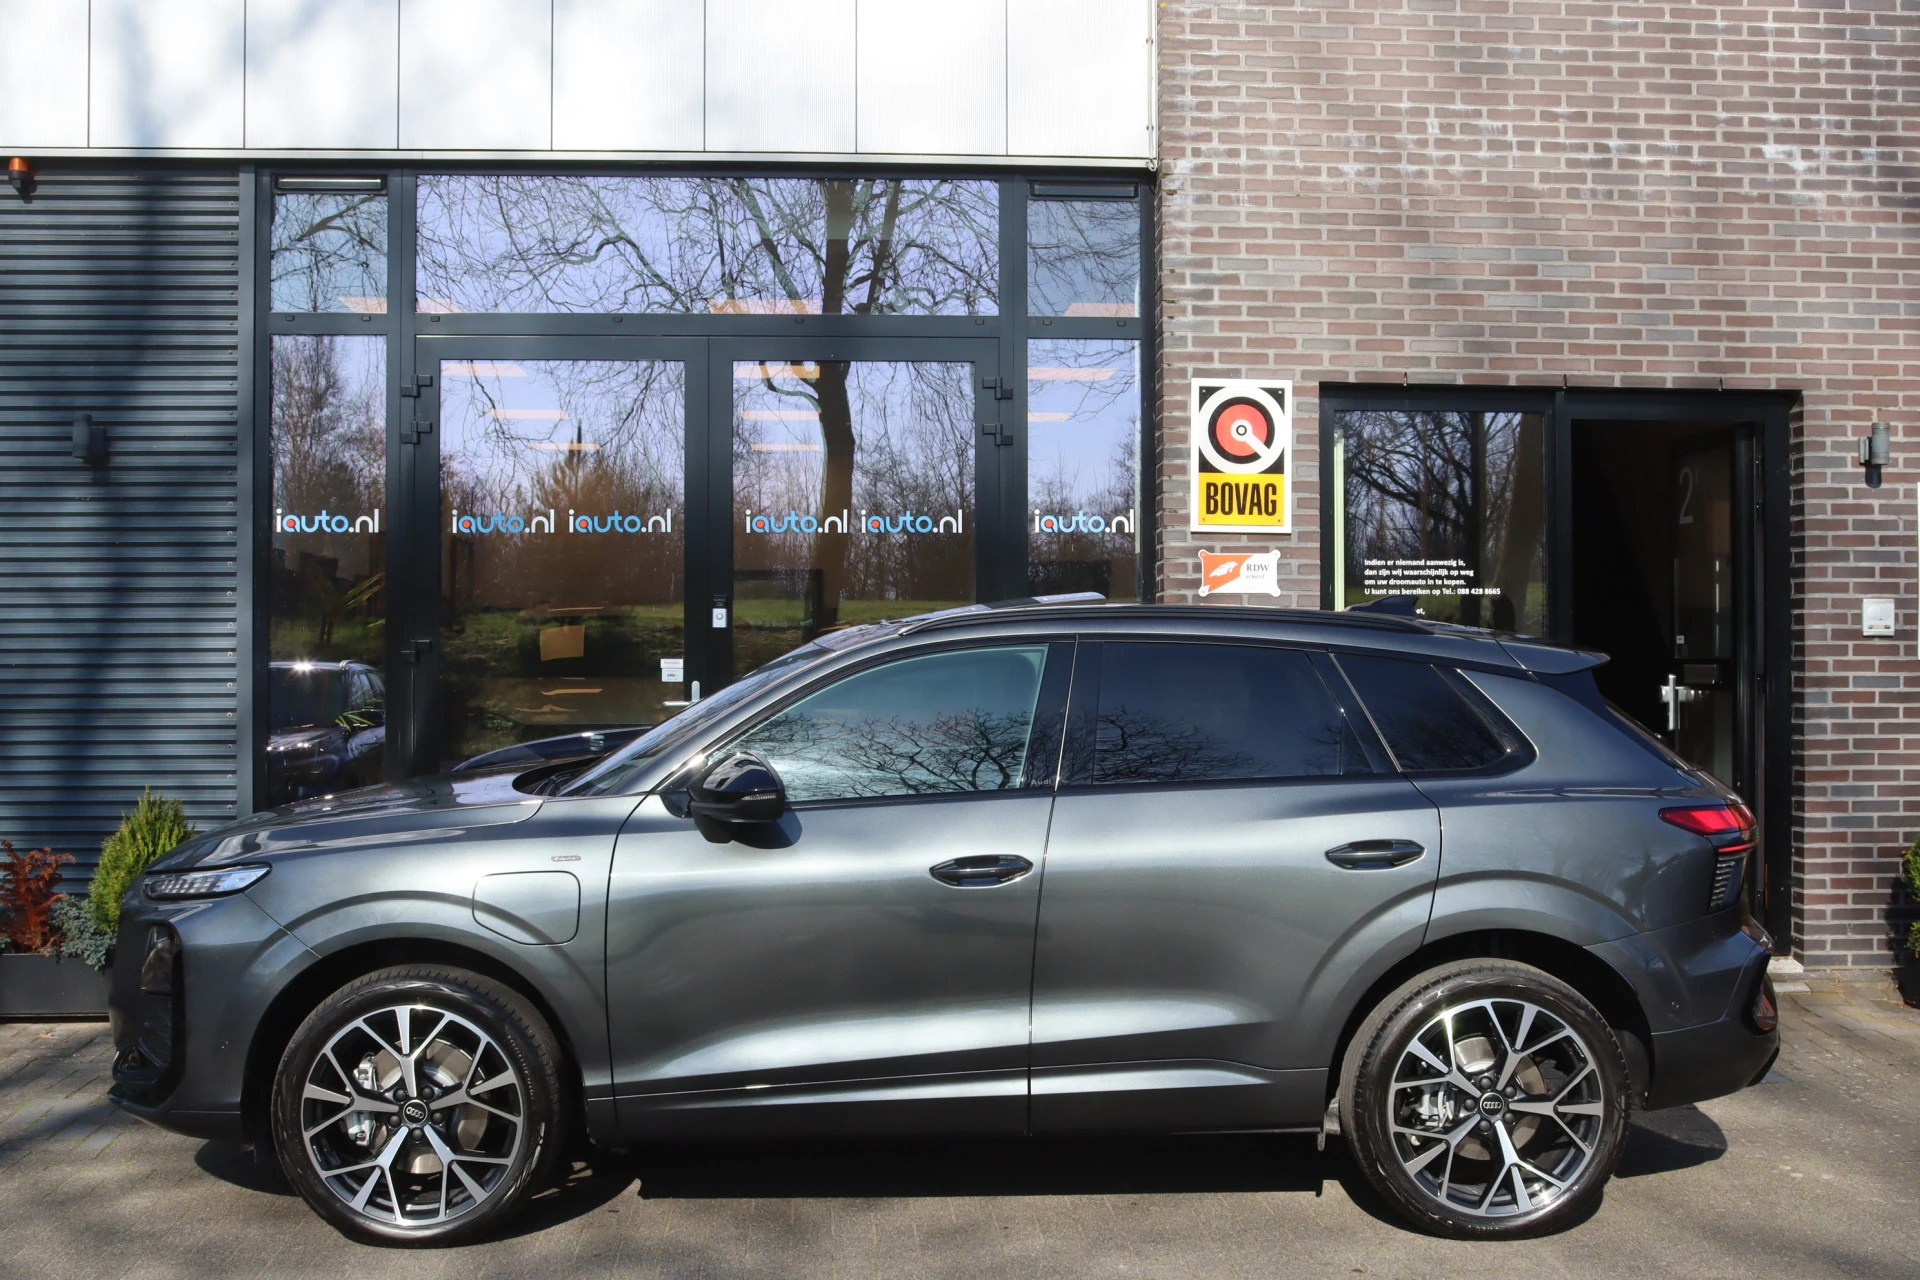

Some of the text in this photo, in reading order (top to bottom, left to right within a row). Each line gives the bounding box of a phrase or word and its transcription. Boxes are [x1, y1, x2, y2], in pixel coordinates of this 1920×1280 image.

[1206, 482, 1277, 516] BOVAG
[276, 508, 379, 533] iauto.nl
[451, 508, 555, 533] iauto.nl
[569, 508, 672, 533] iauto.nl
[745, 508, 848, 533] iauto.nl
[861, 508, 963, 533] iauto.nl
[1034, 508, 1135, 533] iauto.nl
[1246, 563, 1270, 572] RDW
[1378, 569, 1391, 577] zijn
[1391, 569, 1403, 577] wij
[1403, 569, 1449, 577] waarschijnlijk
[1426, 559, 1457, 568] aanwezig
[1458, 559, 1466, 567] is,
[1388, 578, 1427, 586] droomauto
[1427, 578, 1435, 586] in
[1443, 578, 1466, 587] kopen.
[1431, 589, 1441, 597] op
